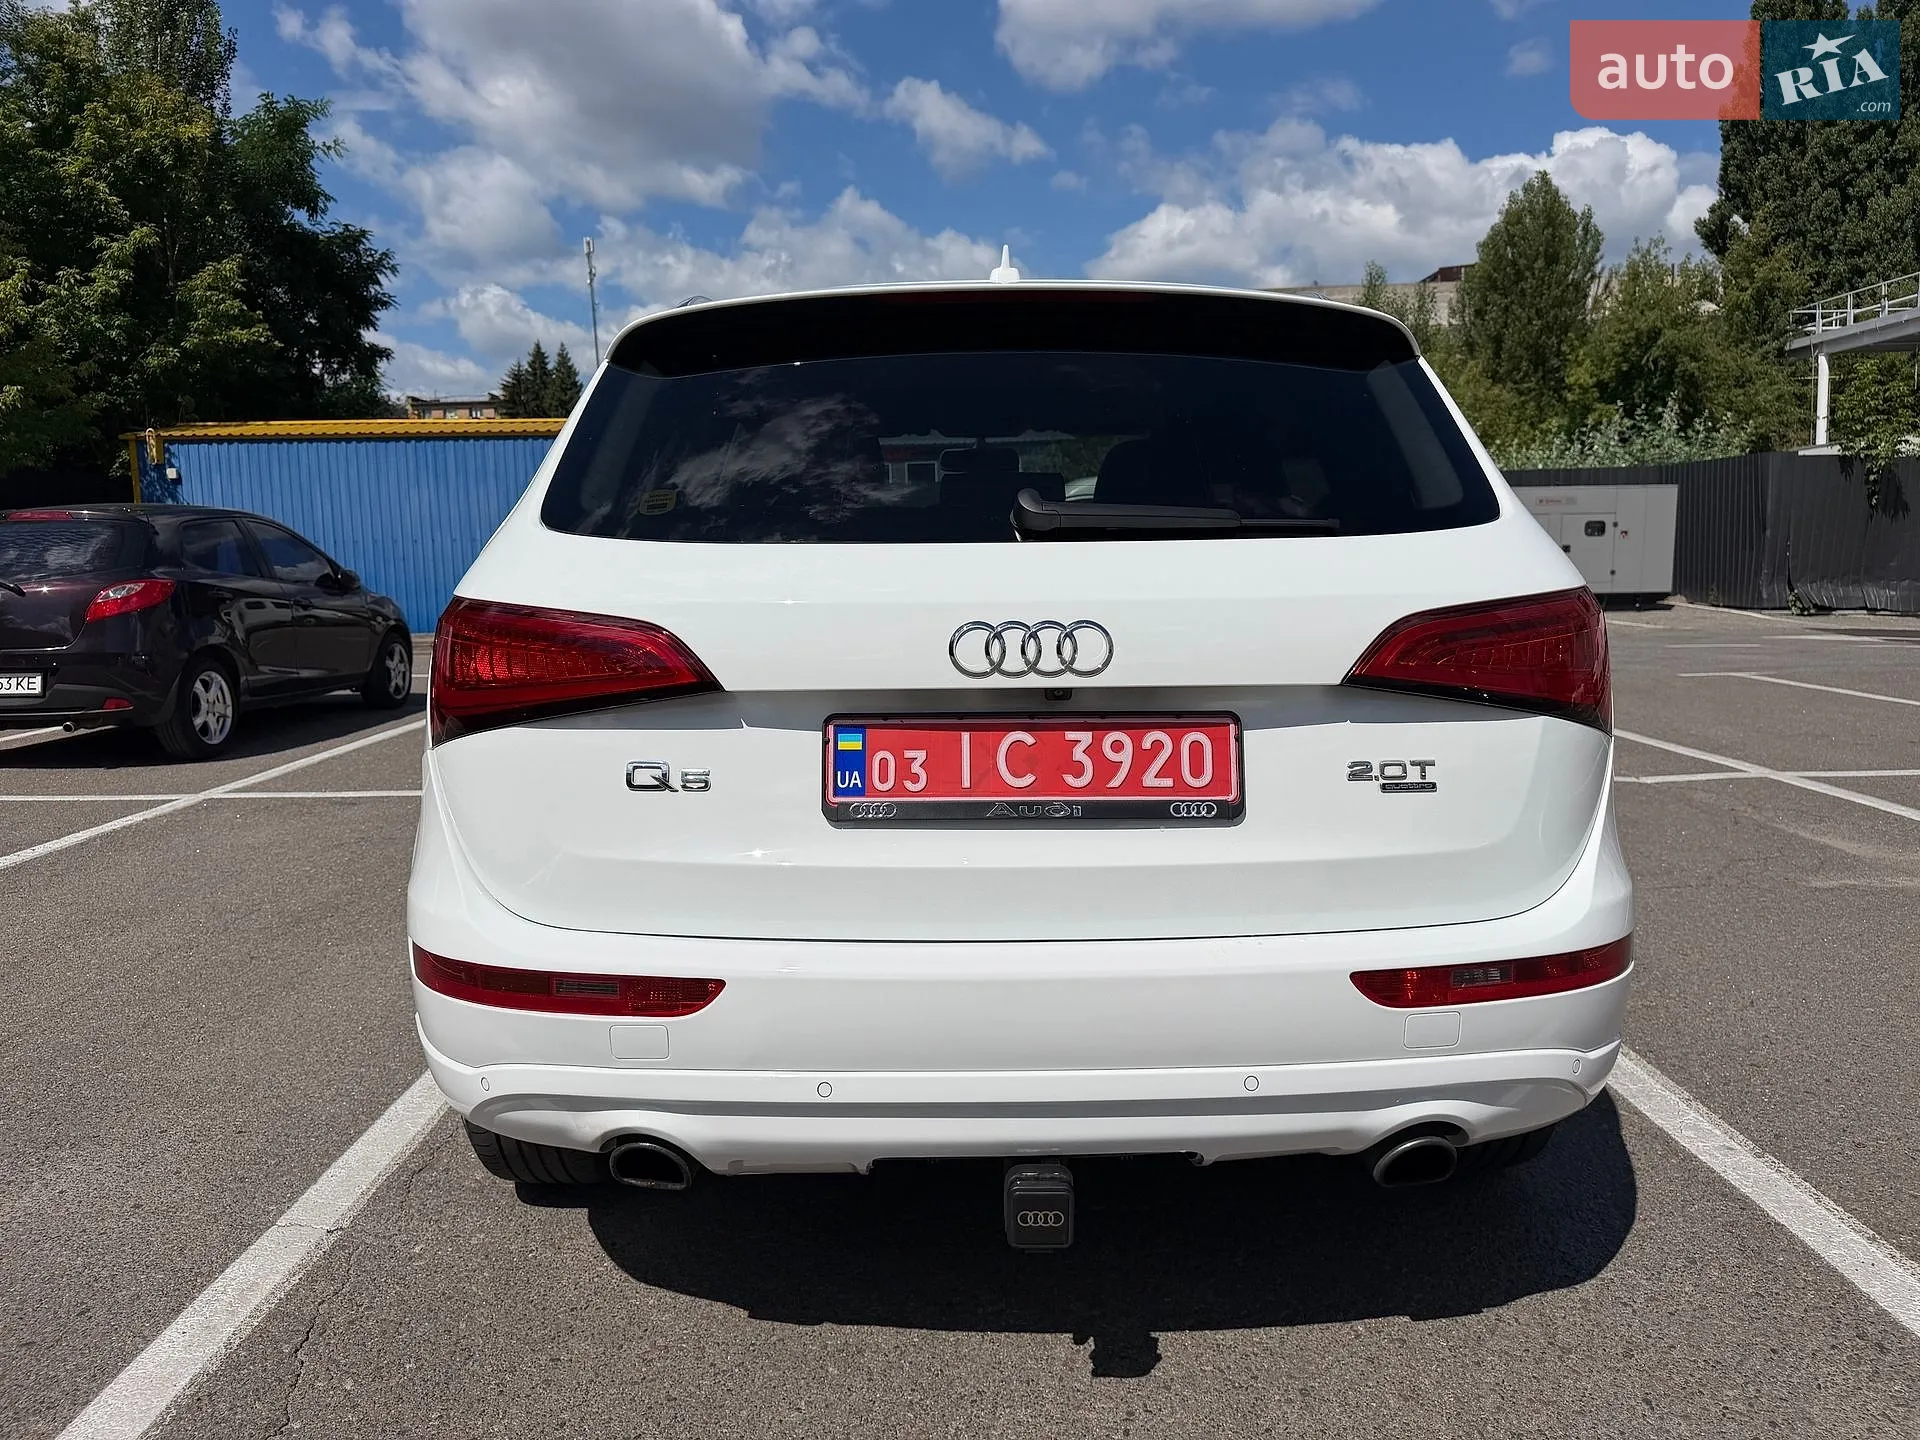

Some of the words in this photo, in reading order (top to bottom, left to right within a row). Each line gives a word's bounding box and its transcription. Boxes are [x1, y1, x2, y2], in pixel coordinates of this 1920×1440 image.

[16, 676, 37, 690] KE
[871, 750, 928, 792] 03
[1062, 731, 1214, 789] 3920
[1347, 759, 1435, 781] 2.0T
[626, 760, 711, 792] Q5
[837, 771, 862, 788] UA
[1384, 782, 1434, 791] quattro
